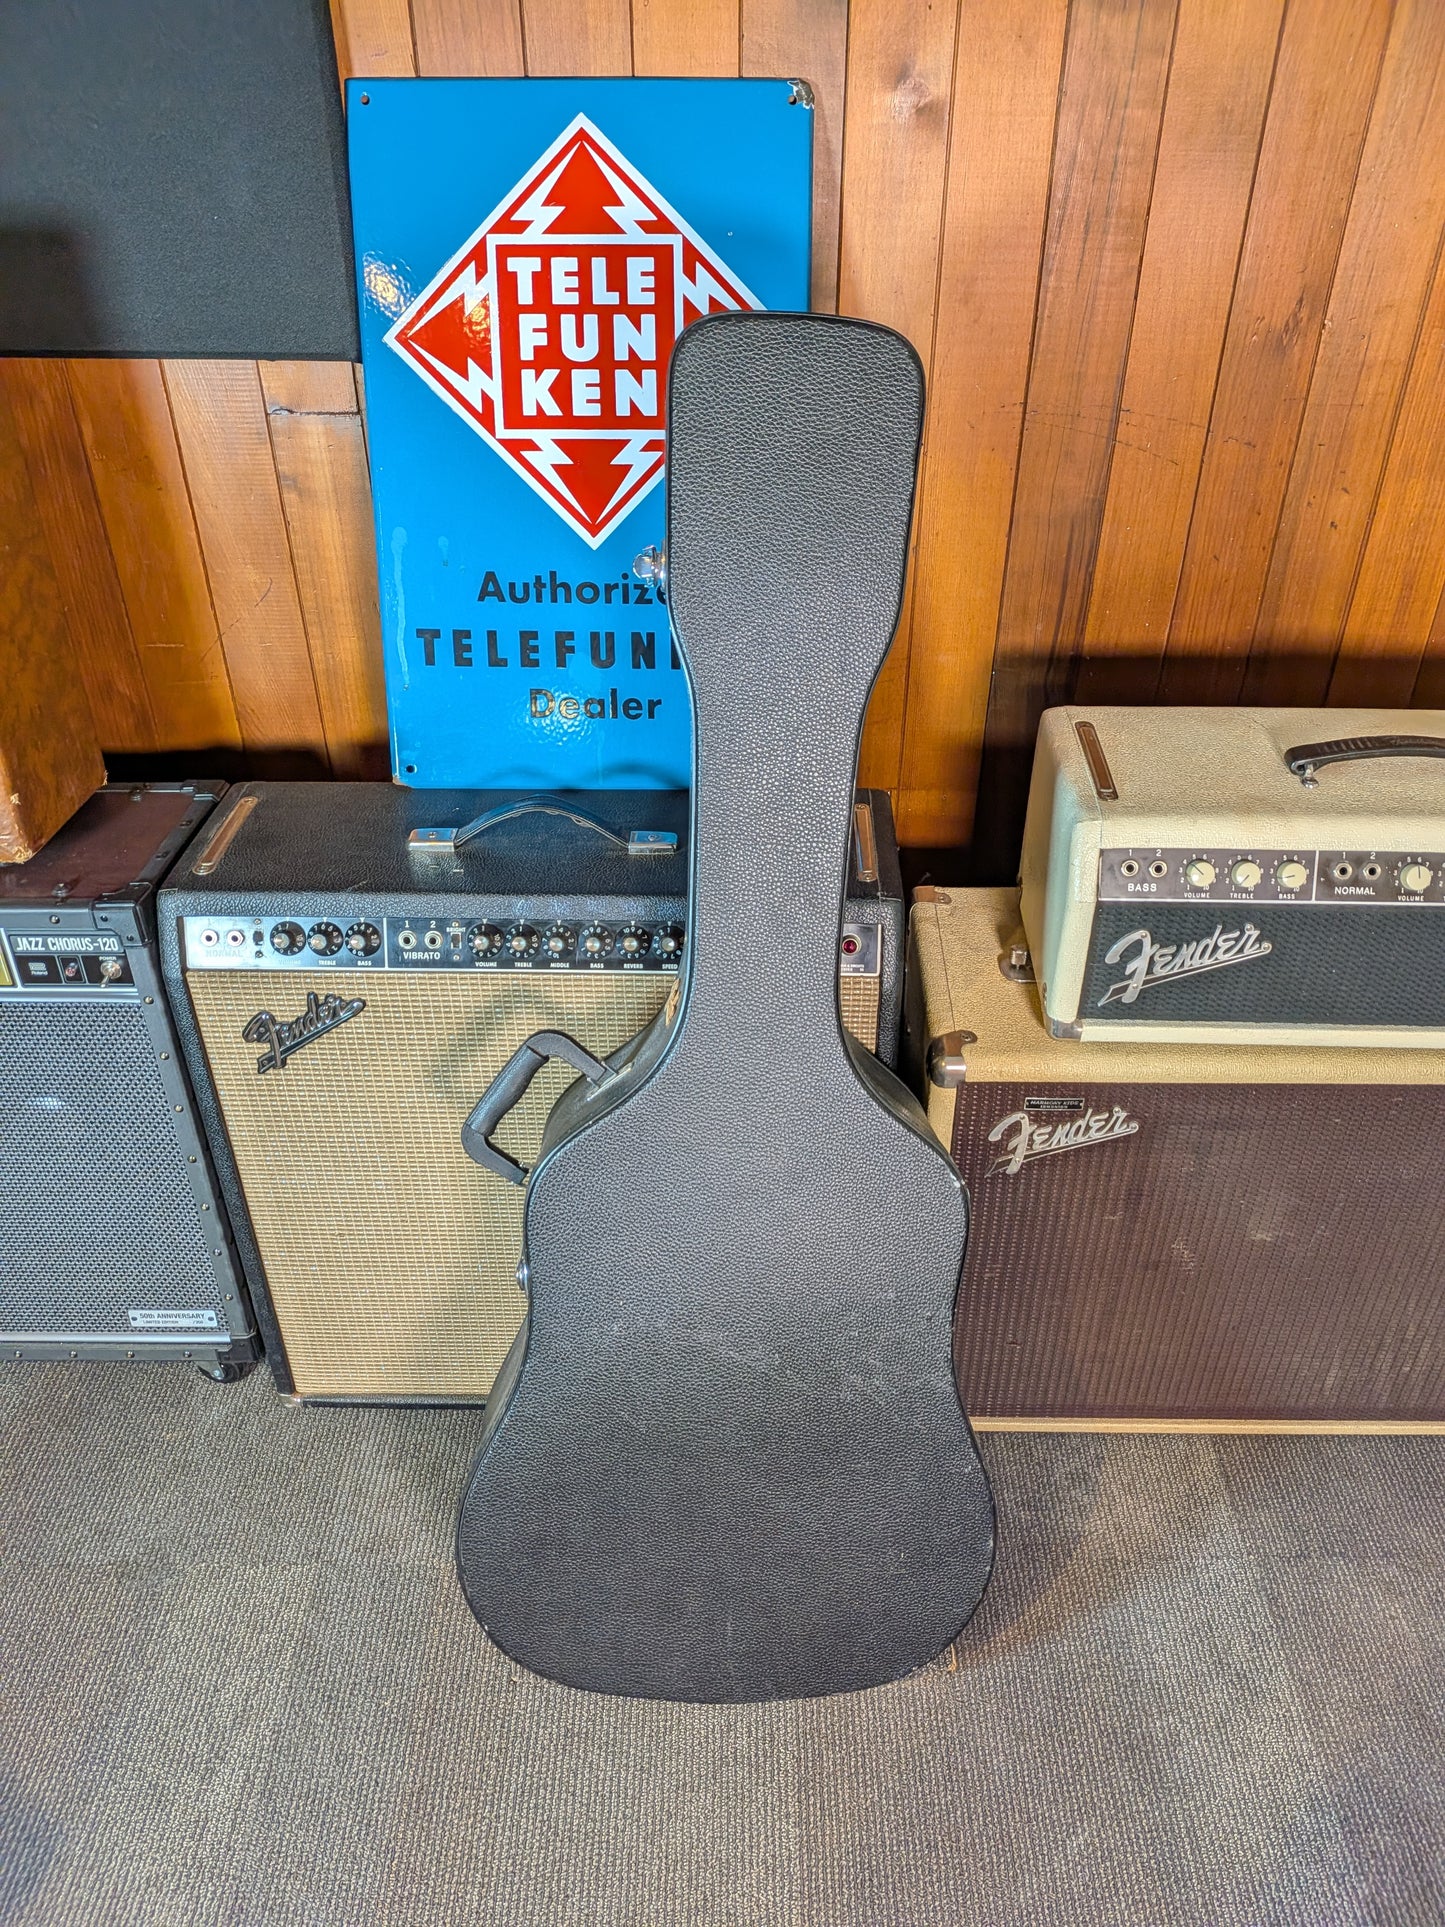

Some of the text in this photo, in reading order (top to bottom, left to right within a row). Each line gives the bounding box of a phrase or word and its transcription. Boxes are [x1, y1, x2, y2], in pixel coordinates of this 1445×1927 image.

[507, 256, 655, 305] TELE
[518, 313, 656, 361] FUN
[521, 369, 657, 416] KEN
[529, 688, 662, 720] Dealer
[1127, 883, 1157, 892] BASS
[1334, 886, 1376, 895] NORMAL
[430, 920, 436, 928] 2
[16, 937, 119, 951] JAZZ CHORUS-120
[403, 952, 440, 960] VIBRATO
[1102, 922, 1271, 1004] Fender
[242, 991, 366, 1074] Fender
[986, 1107, 1138, 1176] Fender
